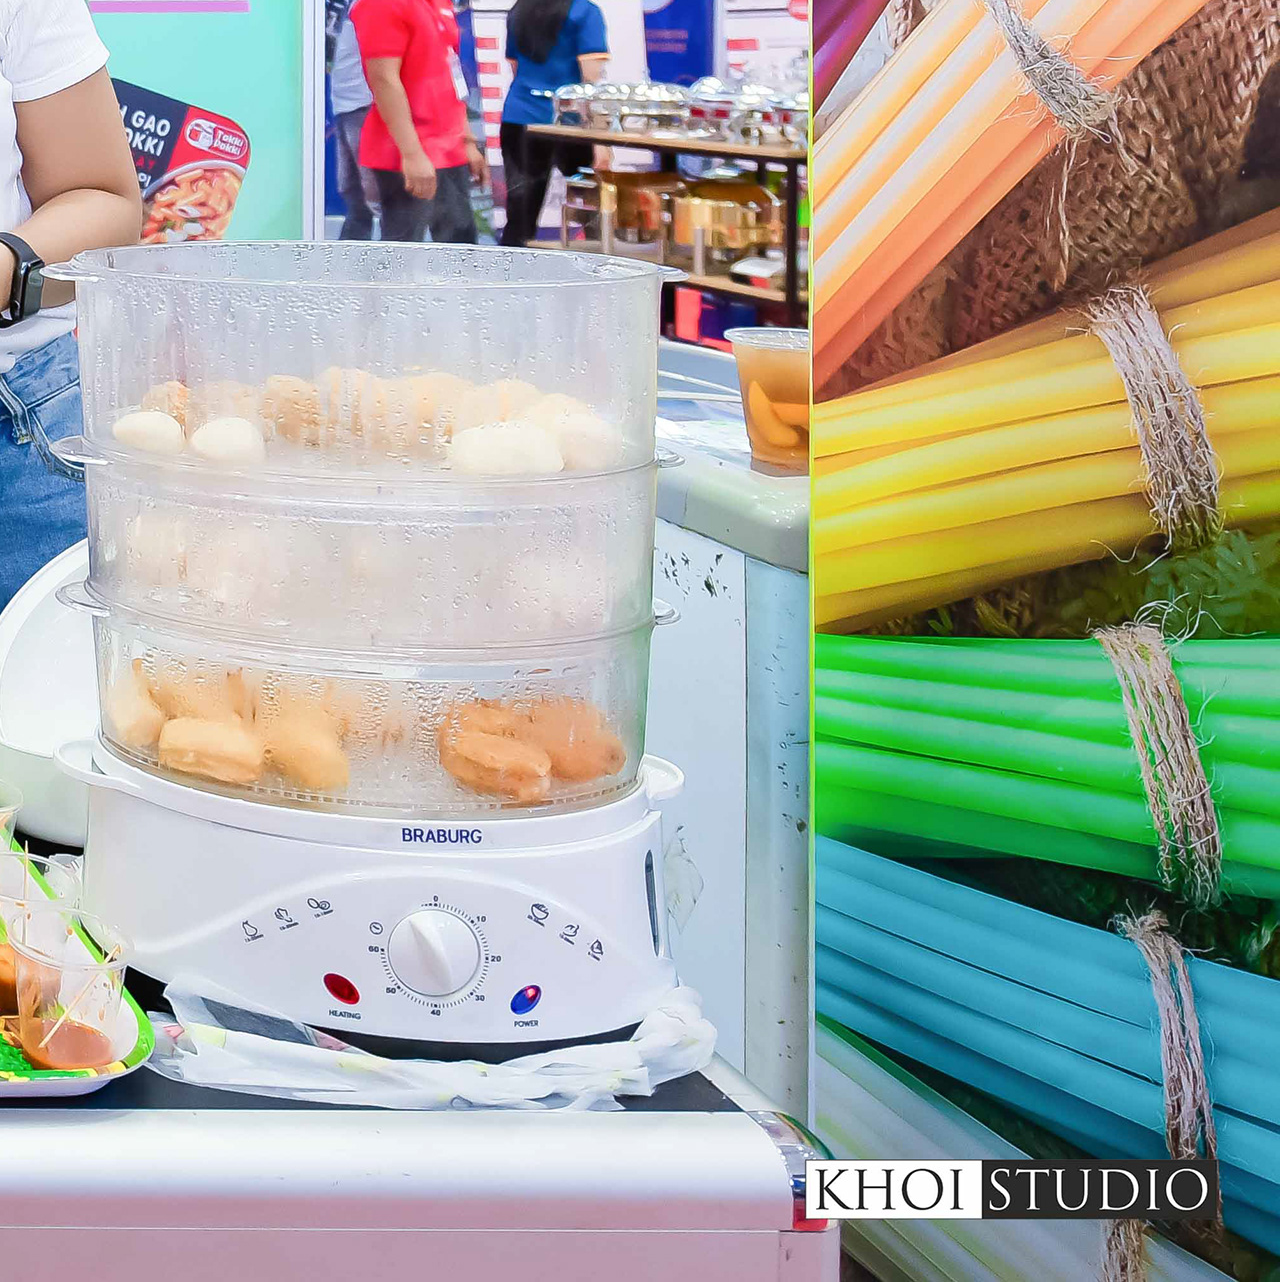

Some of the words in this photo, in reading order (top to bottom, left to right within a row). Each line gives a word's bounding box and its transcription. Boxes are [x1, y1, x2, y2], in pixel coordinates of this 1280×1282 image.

[401, 827, 483, 845] BRABURG
[476, 915, 487, 923] 10
[475, 994, 485, 1002] 30
[328, 1009, 362, 1020] HEATING
[513, 1019, 539, 1027] POWER
